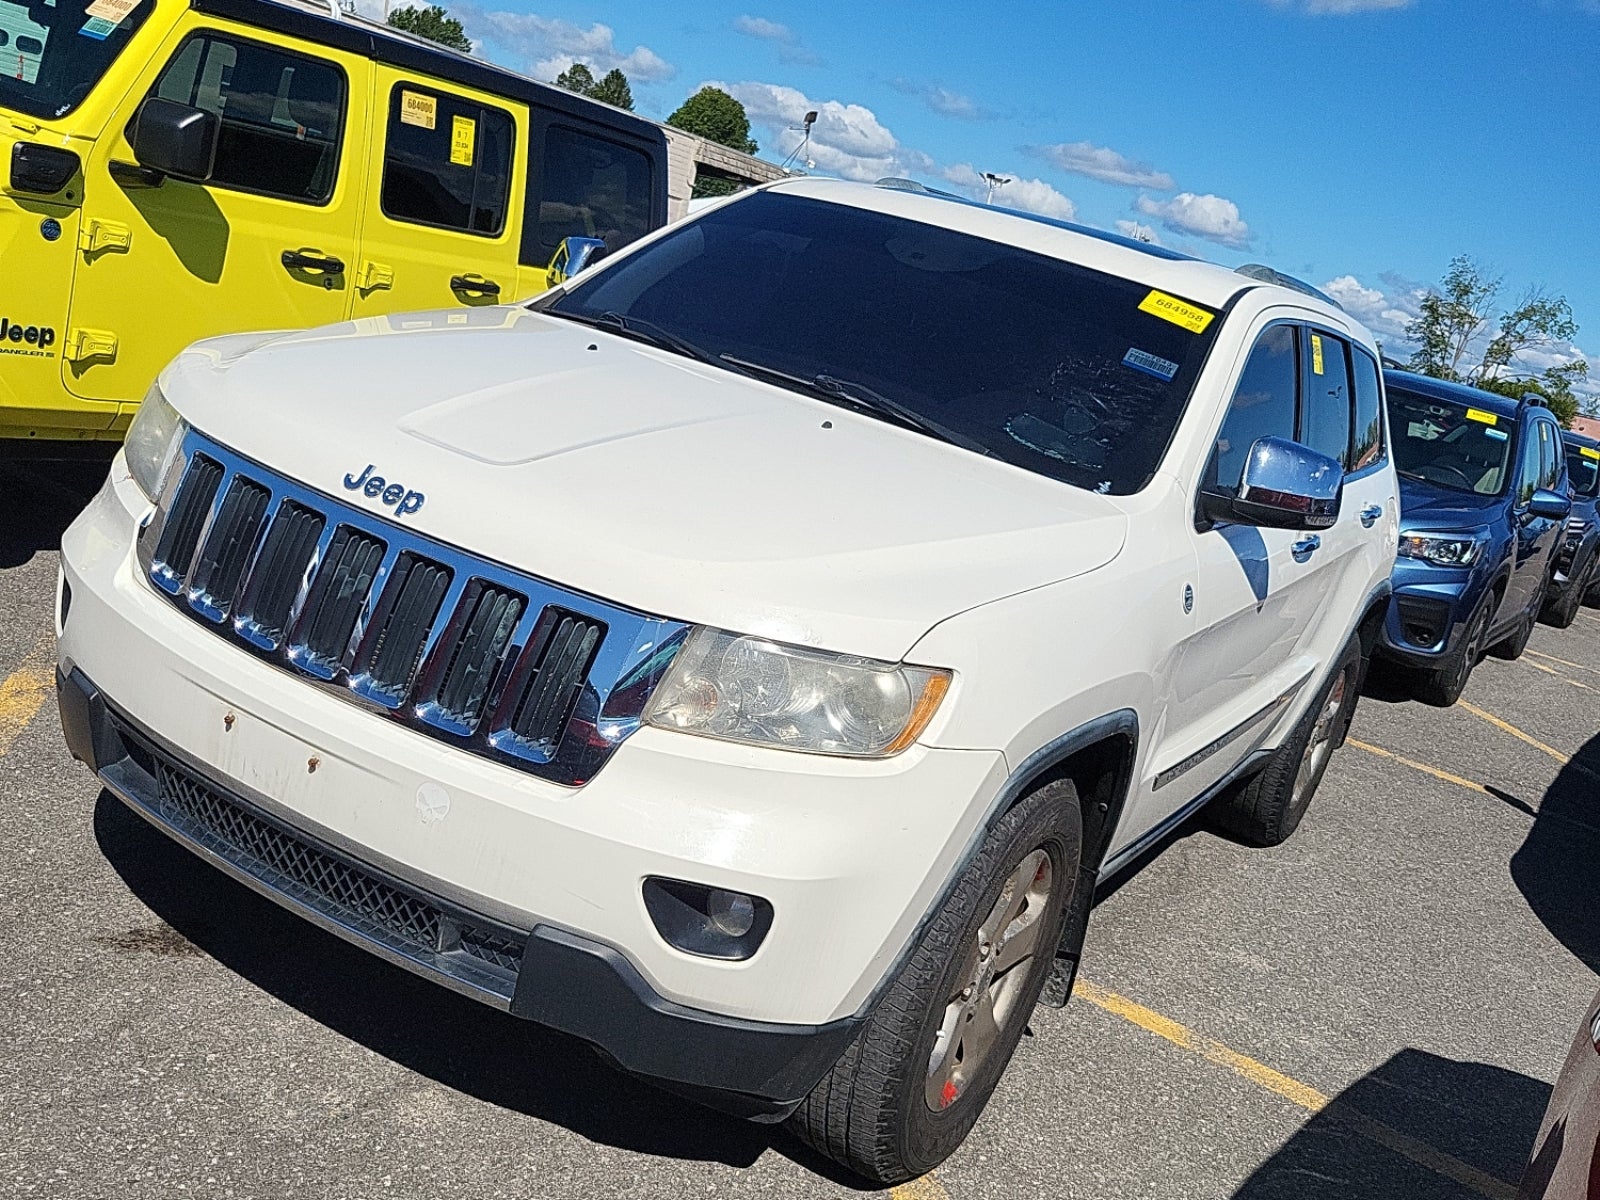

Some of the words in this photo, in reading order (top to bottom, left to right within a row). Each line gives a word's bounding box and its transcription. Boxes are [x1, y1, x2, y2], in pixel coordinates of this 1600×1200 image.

[407, 98, 433, 113] 684000
[1156, 299, 1204, 322] 684958
[0, 318, 55, 349] Jeep
[0, 349, 44, 357] ANGLER
[343, 463, 425, 518] Jeep
